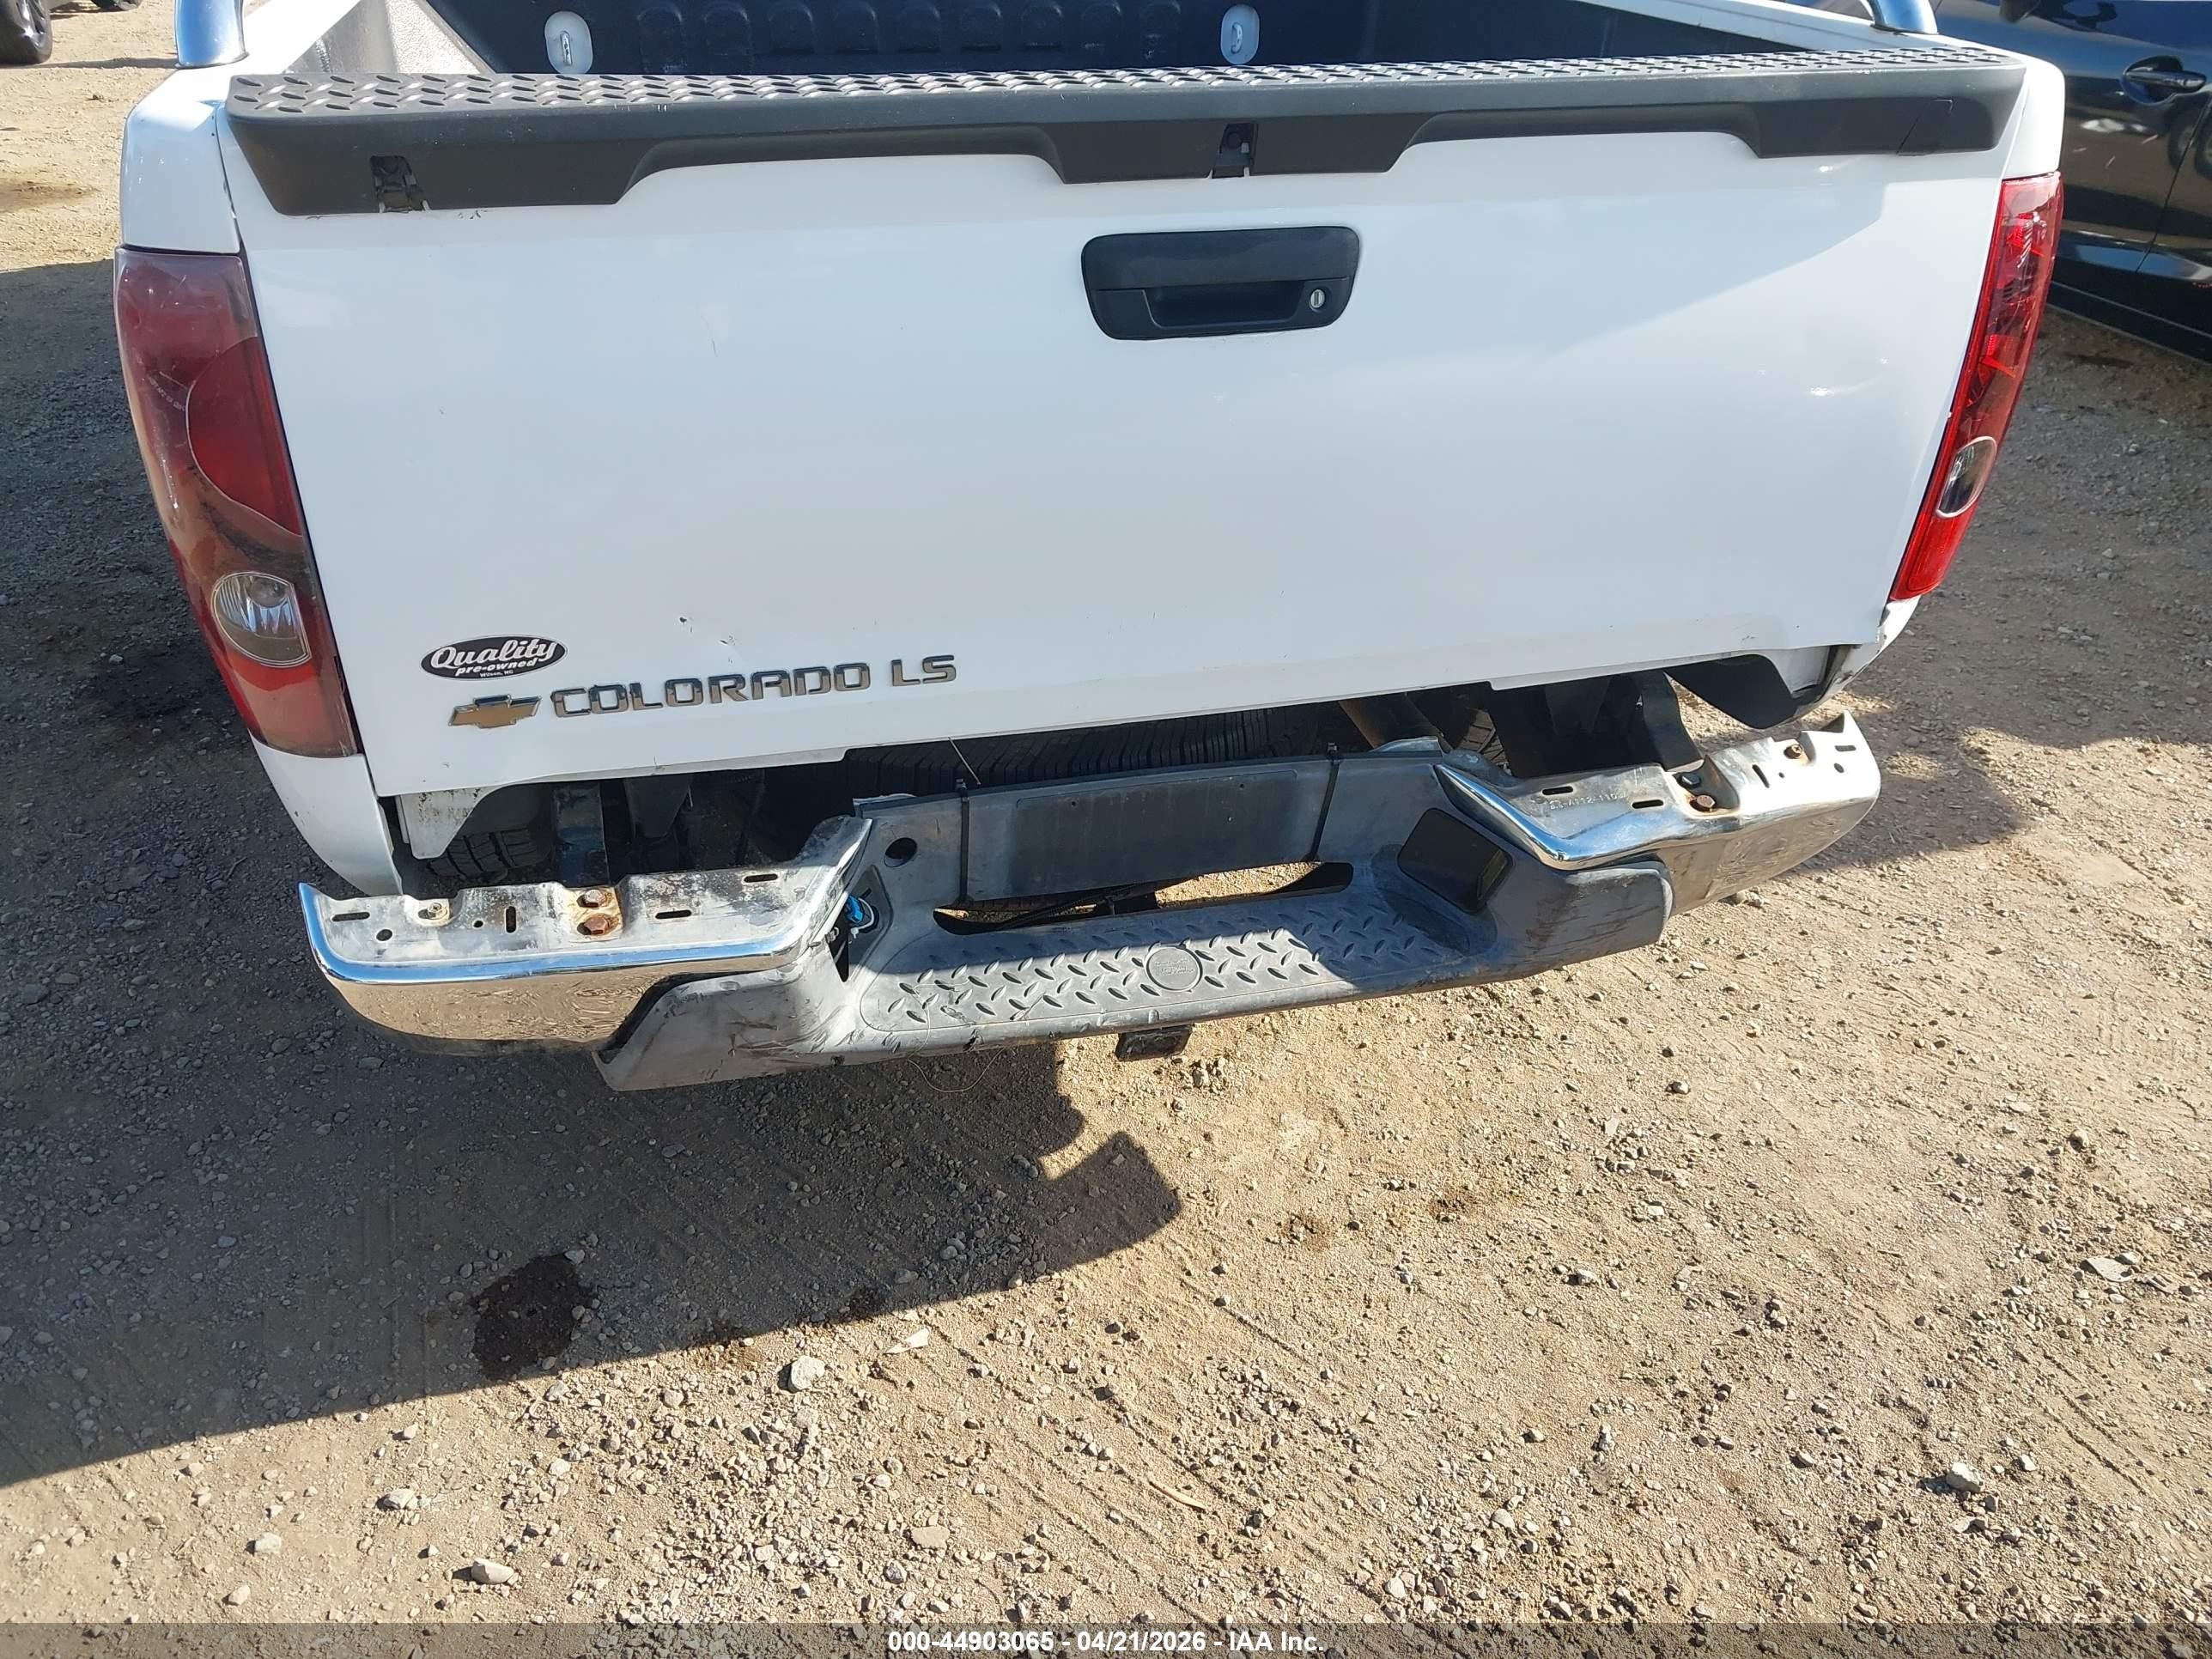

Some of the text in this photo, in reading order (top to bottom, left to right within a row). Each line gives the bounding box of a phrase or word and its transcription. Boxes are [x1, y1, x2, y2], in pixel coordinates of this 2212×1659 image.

[430, 638, 558, 669] Quality
[455, 657, 538, 677] pre-owned
[550, 654, 957, 718] COLORADO LS
